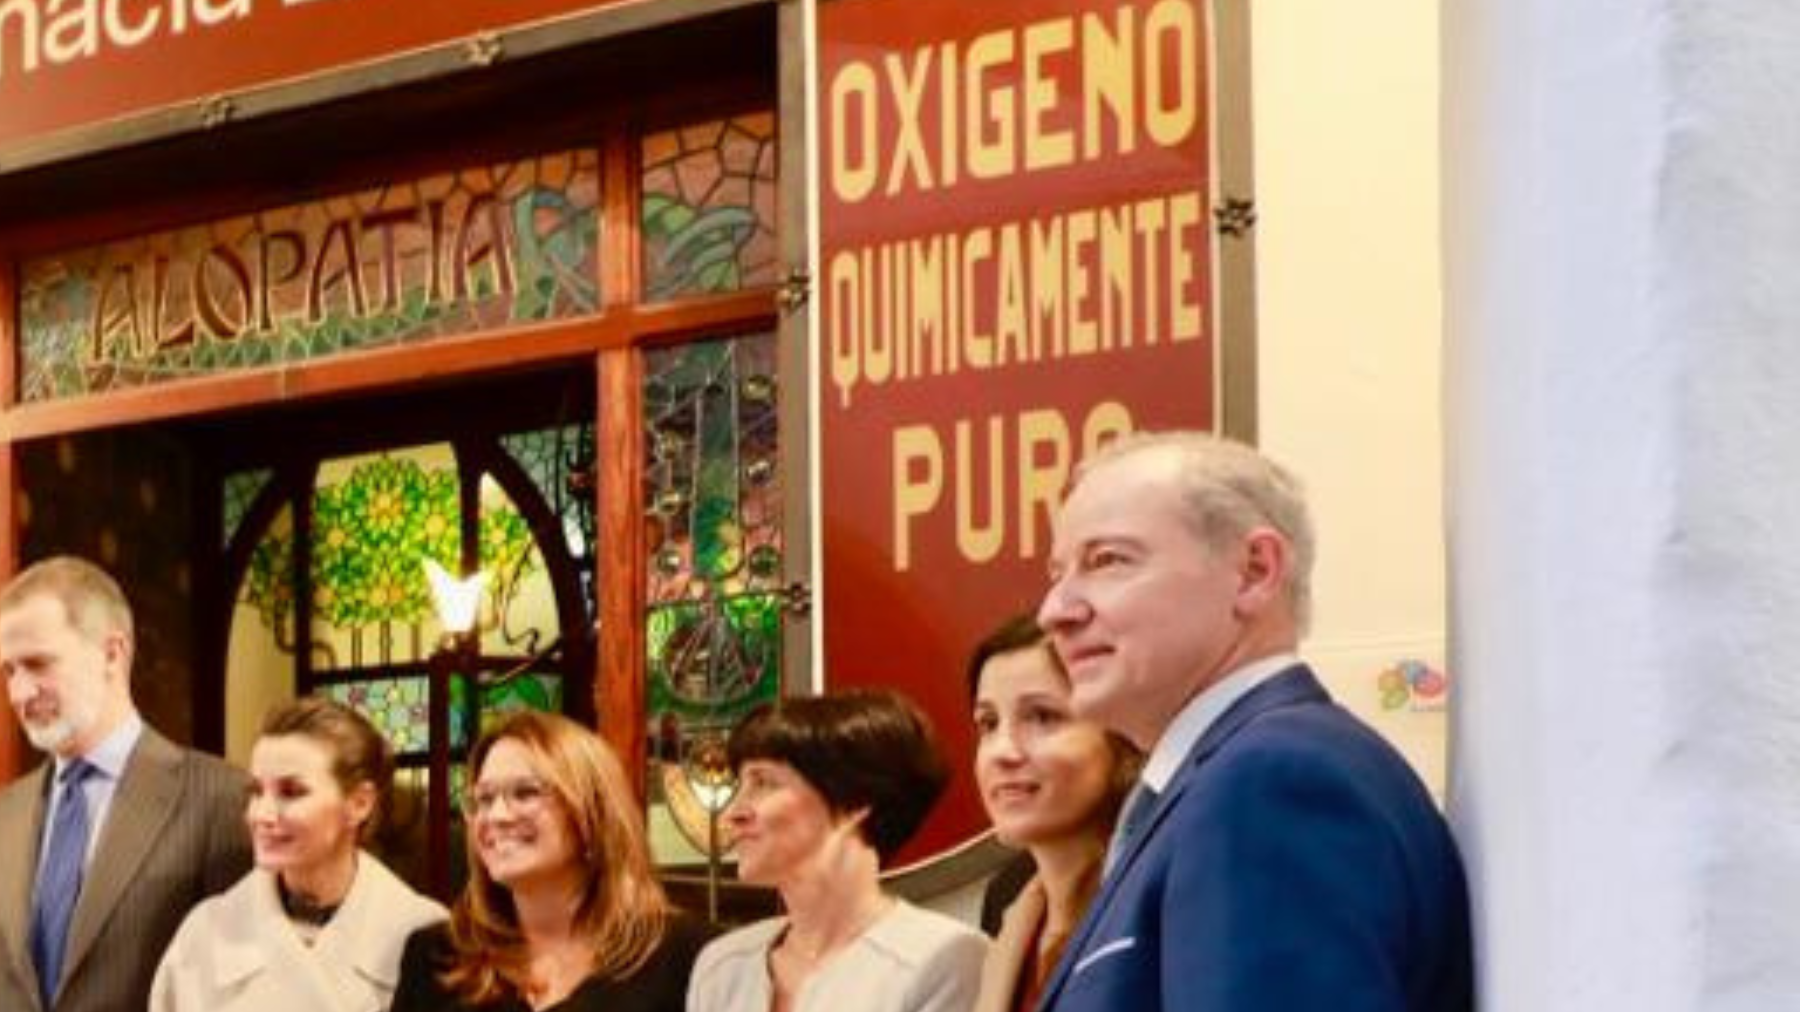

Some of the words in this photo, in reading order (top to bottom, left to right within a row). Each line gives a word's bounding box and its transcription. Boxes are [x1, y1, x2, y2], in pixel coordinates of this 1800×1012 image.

[830, 0, 1198, 203] OXIGENO
[92, 190, 517, 362] ALOPATIA
[830, 192, 1202, 408] QUIMICAMENTE
[893, 401, 1135, 572] PUR
